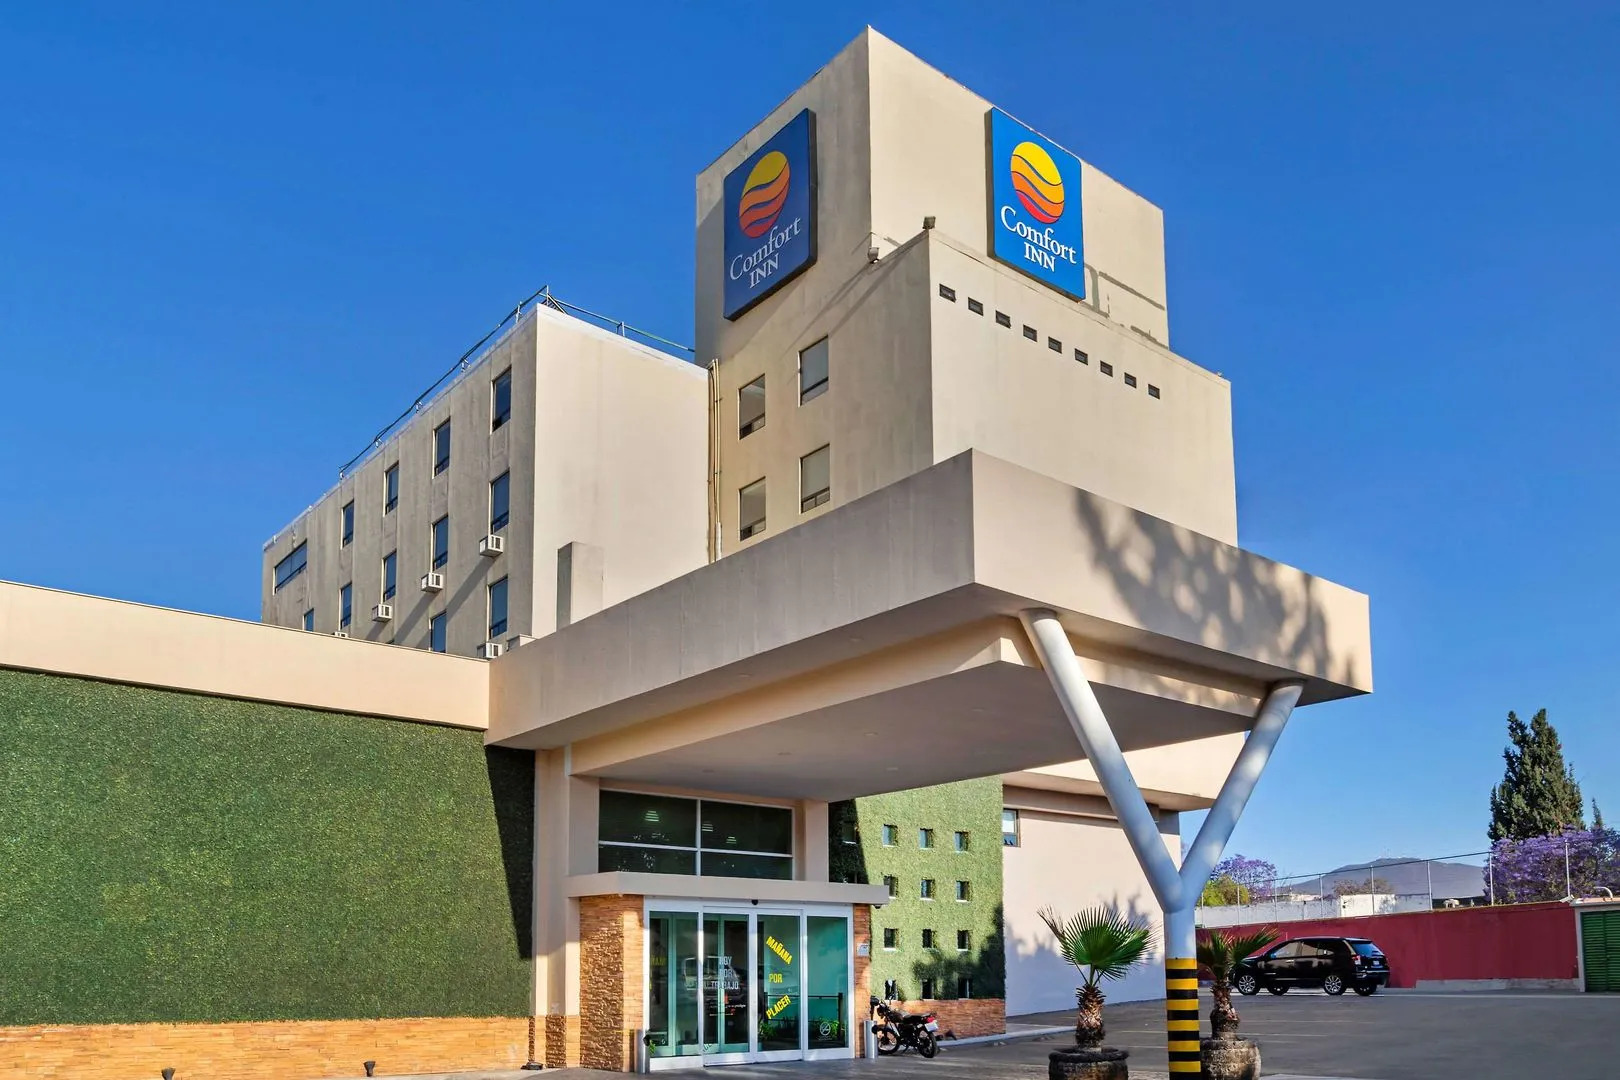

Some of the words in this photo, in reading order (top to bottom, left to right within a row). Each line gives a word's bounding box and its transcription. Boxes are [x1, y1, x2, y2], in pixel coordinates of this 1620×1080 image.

[730, 218, 801, 280] Comfort
[1001, 205, 1077, 264] Comfort
[749, 253, 779, 288] INN
[1024, 241, 1055, 273] INN
[766, 936, 792, 965] MAÑANA
[768, 973, 783, 984] POR
[766, 995, 791, 1020] PLACER
